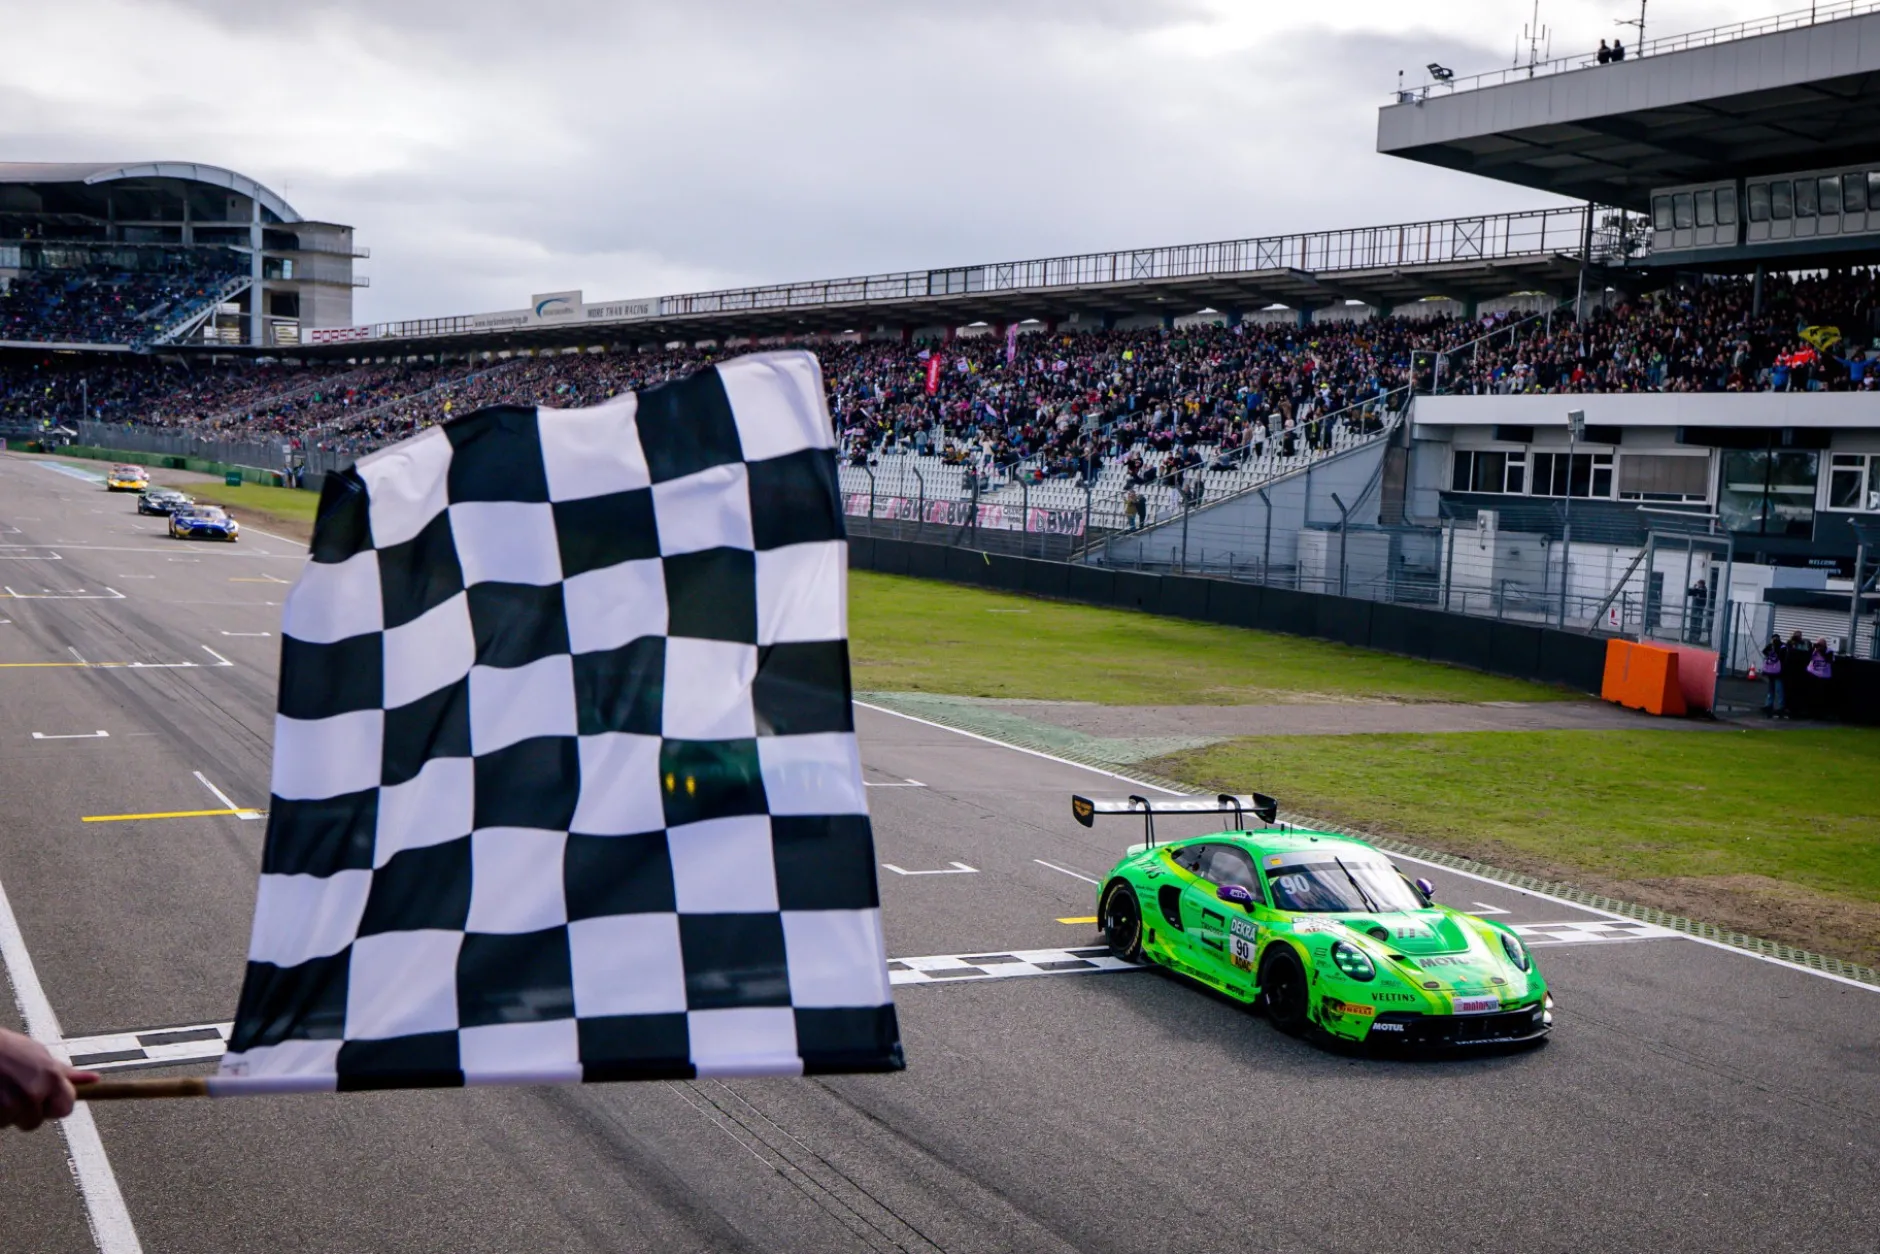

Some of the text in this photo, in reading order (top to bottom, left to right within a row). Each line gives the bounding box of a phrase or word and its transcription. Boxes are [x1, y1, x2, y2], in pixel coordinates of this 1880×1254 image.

[587, 307, 604, 318] MORE
[605, 305, 622, 317] THAN
[624, 303, 649, 316] RACING
[1046, 511, 1083, 535] BWT
[1280, 874, 1310, 894] 90
[1231, 918, 1257, 941] DEKRA
[1236, 939, 1249, 959] 90
[1235, 955, 1251, 971] ADAC
[1419, 956, 1475, 968] MOTU
[1371, 992, 1416, 1002] VELTINS
[1339, 1003, 1373, 1016] PIRELLI
[1372, 1022, 1404, 1032] MOTUL
